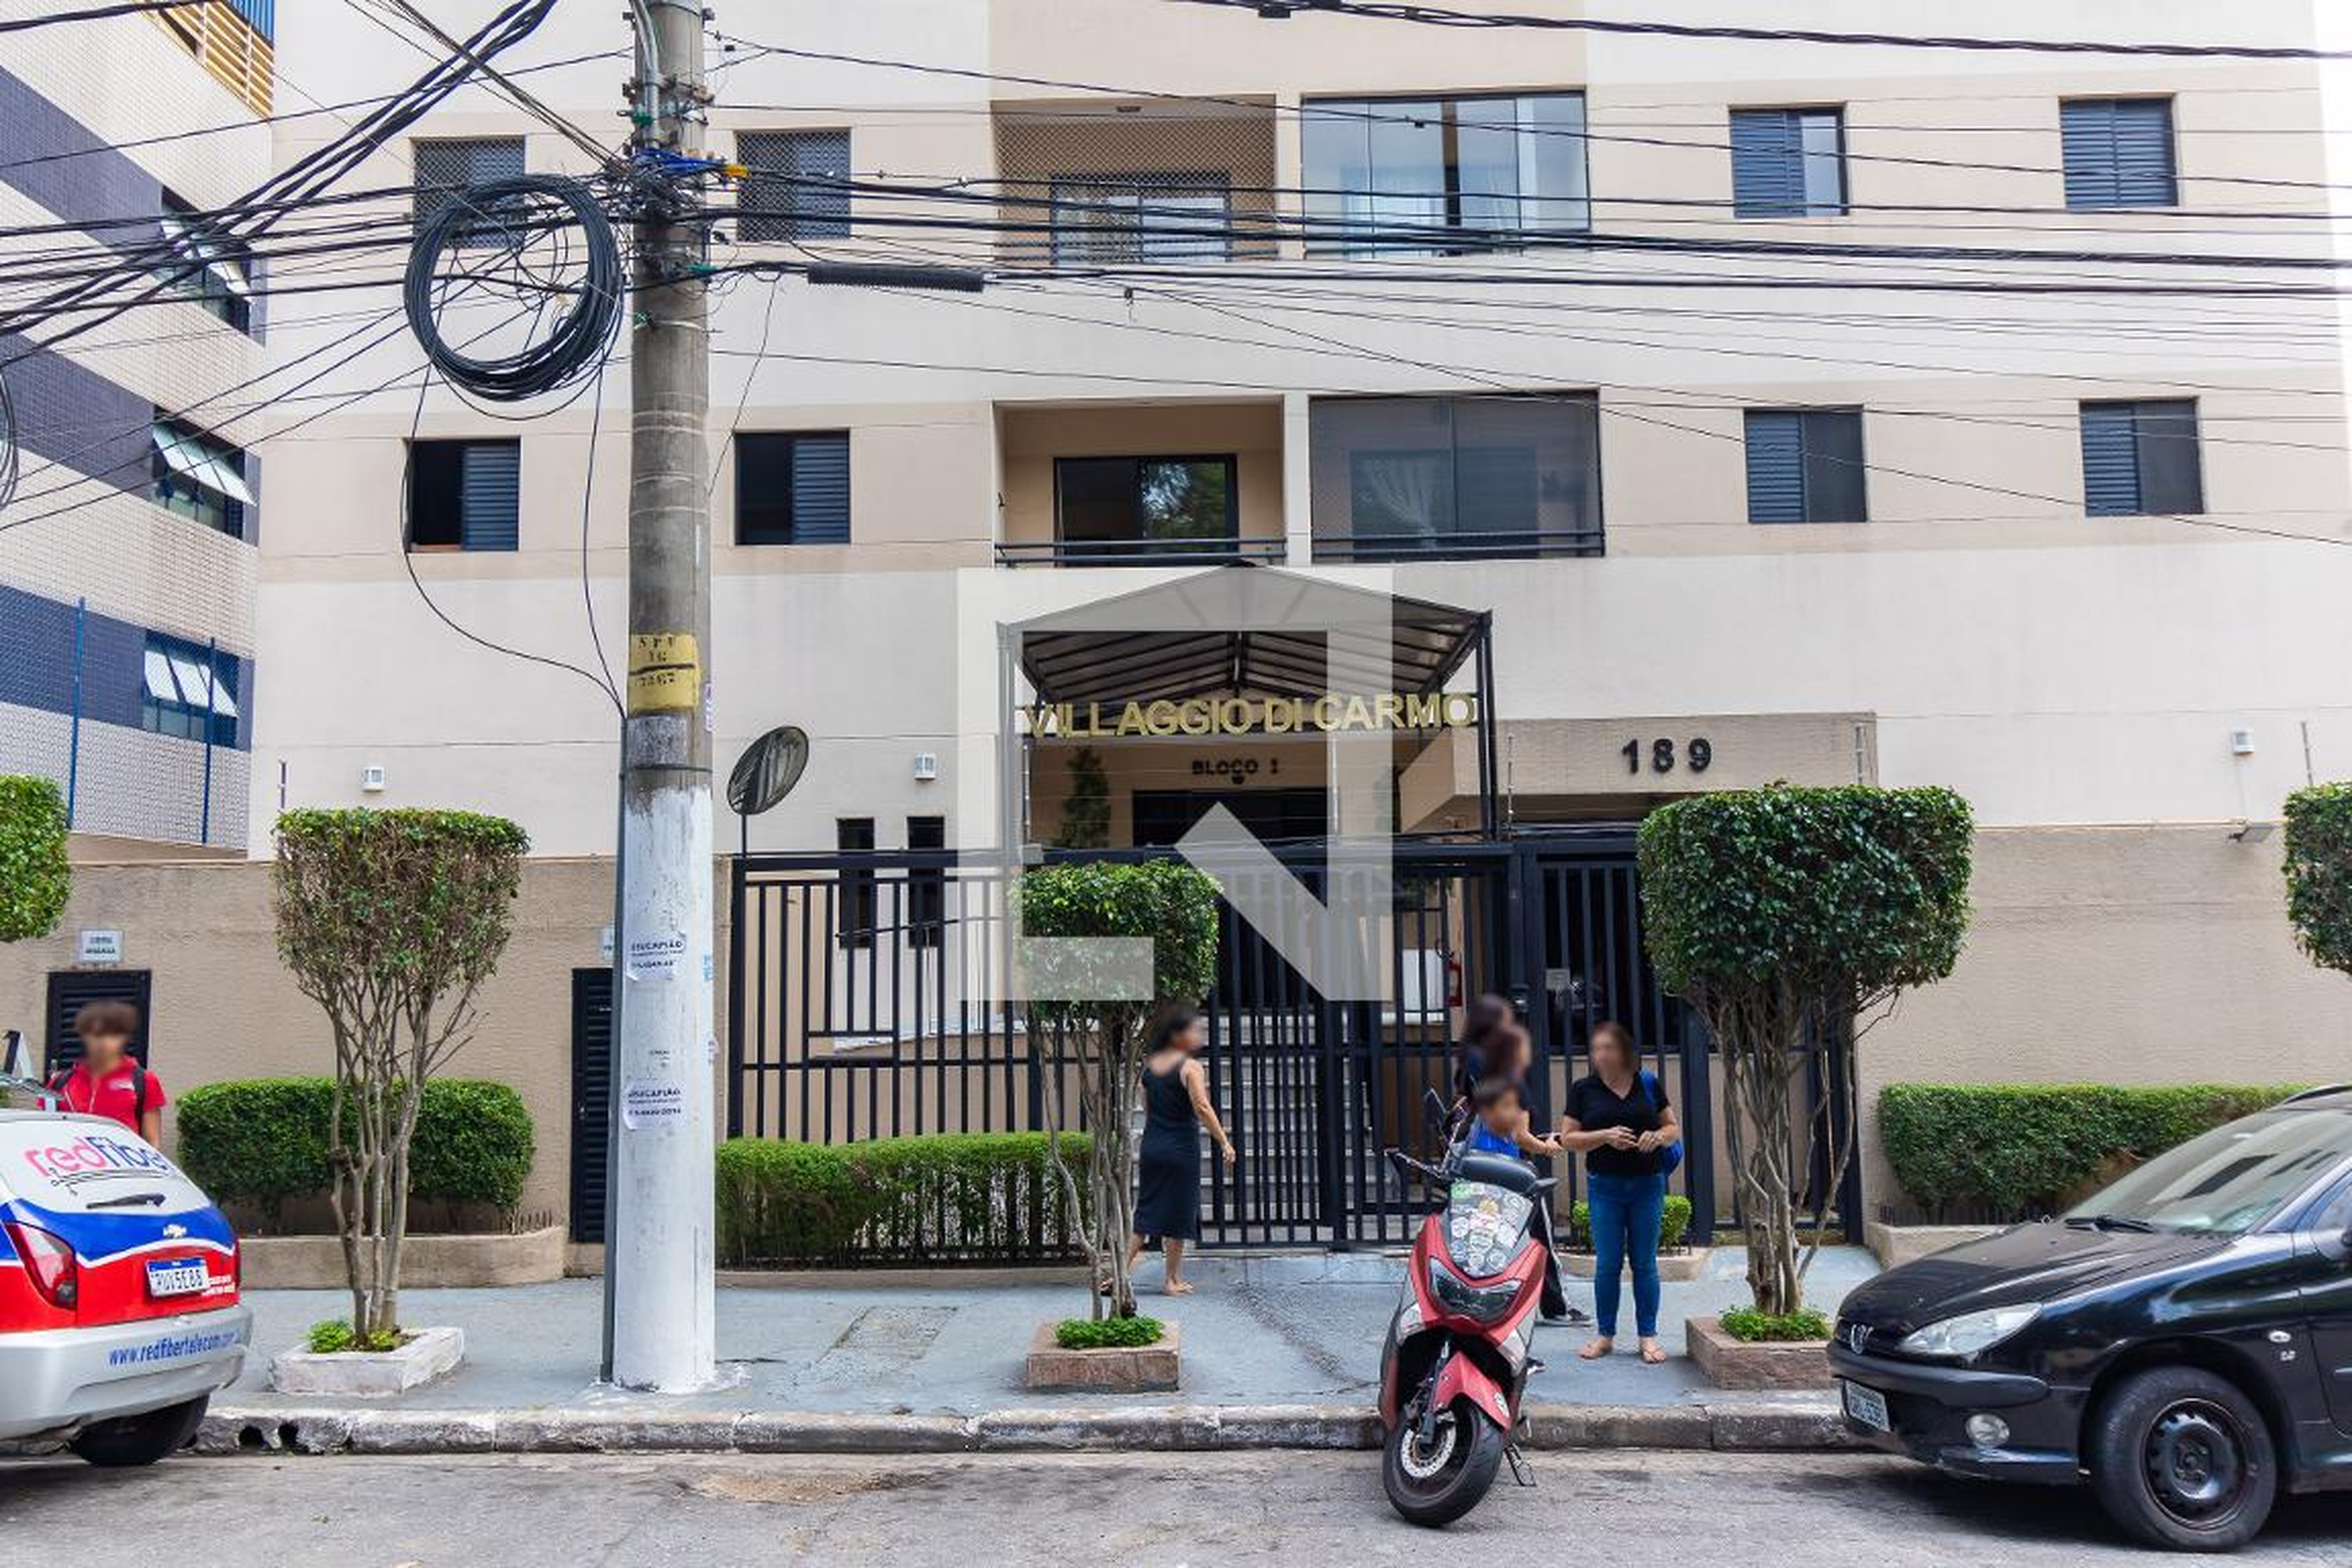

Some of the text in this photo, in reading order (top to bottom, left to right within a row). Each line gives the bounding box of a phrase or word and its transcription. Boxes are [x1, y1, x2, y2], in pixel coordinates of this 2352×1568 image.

[1023, 692, 1474, 737] VILLAGGIO DI CARMO
[1192, 759, 1258, 776] BLOCO
[1623, 738, 1711, 774] 189
